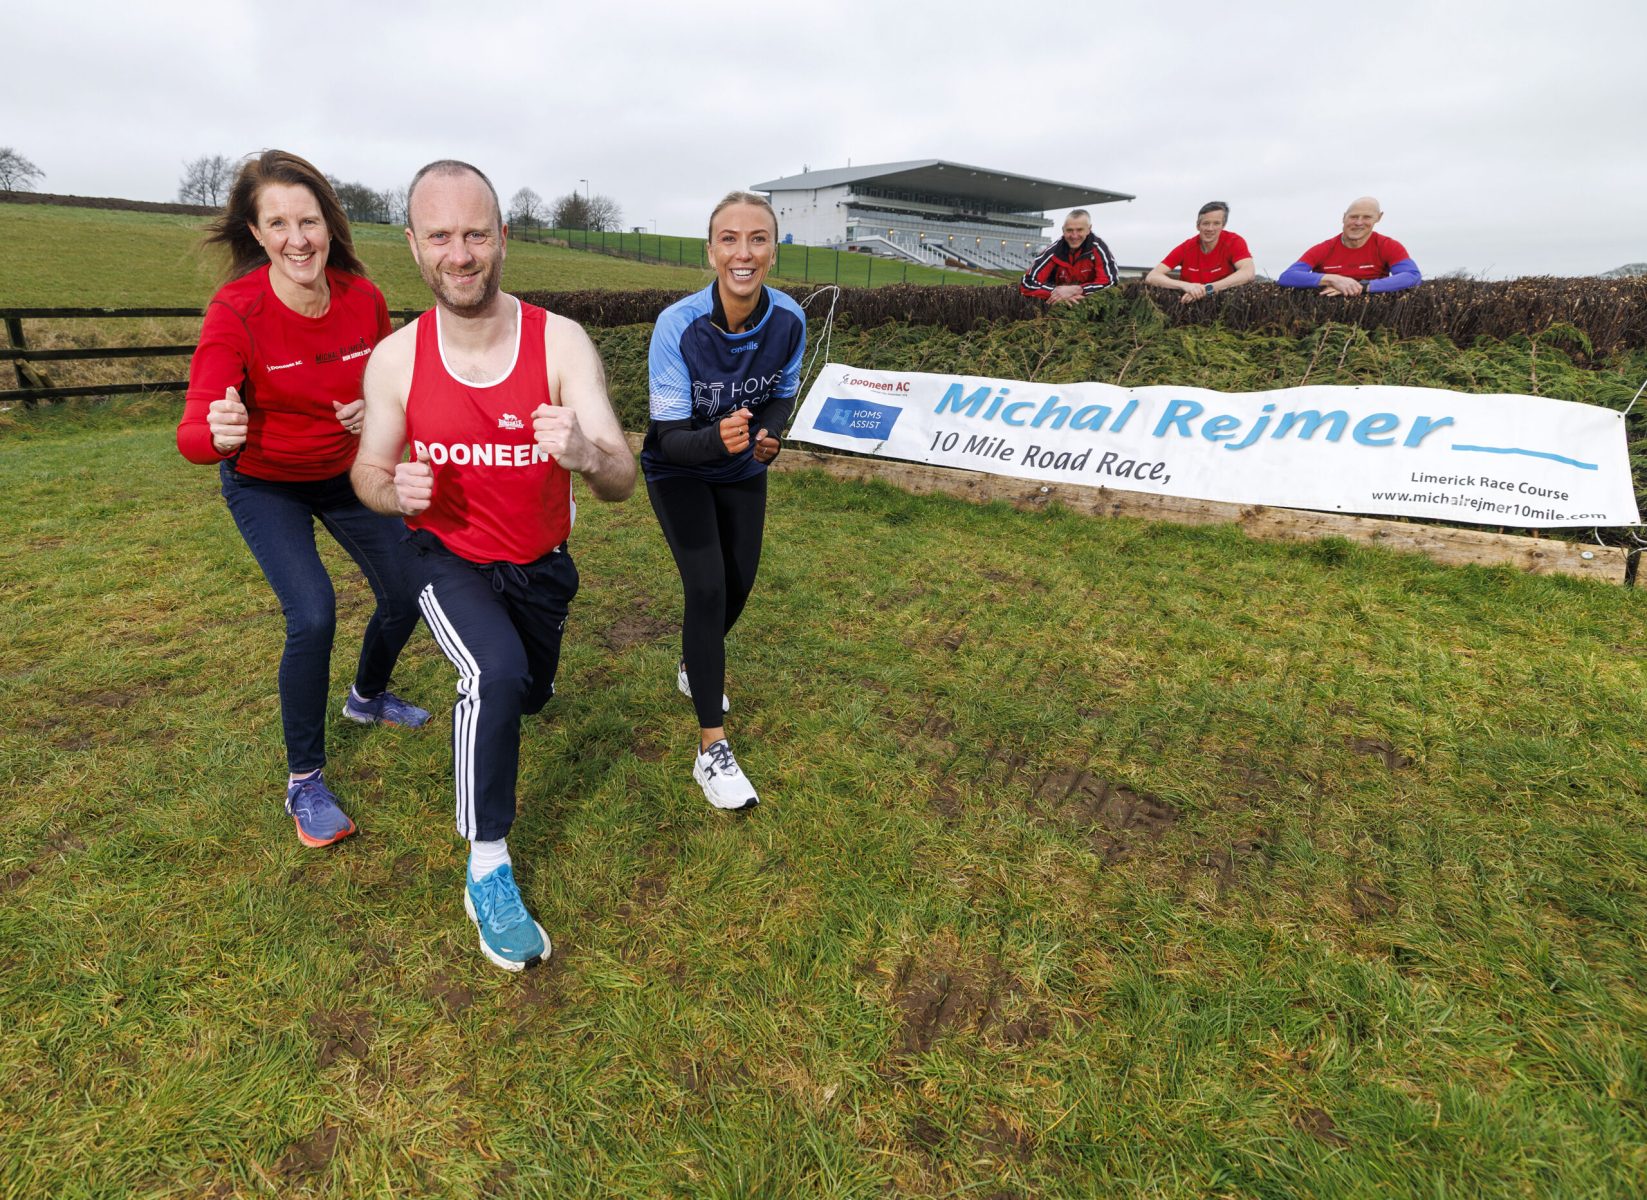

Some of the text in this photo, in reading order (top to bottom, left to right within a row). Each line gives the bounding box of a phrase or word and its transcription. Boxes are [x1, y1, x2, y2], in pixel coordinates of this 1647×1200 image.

[895, 381, 911, 392] AC
[849, 420, 881, 429] ASSIST
[853, 409, 882, 419] HOMS
[934, 383, 1454, 451] Michal Rejmer
[929, 430, 1171, 485] 10 Mile Road Race,
[1411, 472, 1569, 501] Limerick Race Course
[1372, 491, 1607, 521] www.michalrejmer10mile.com
